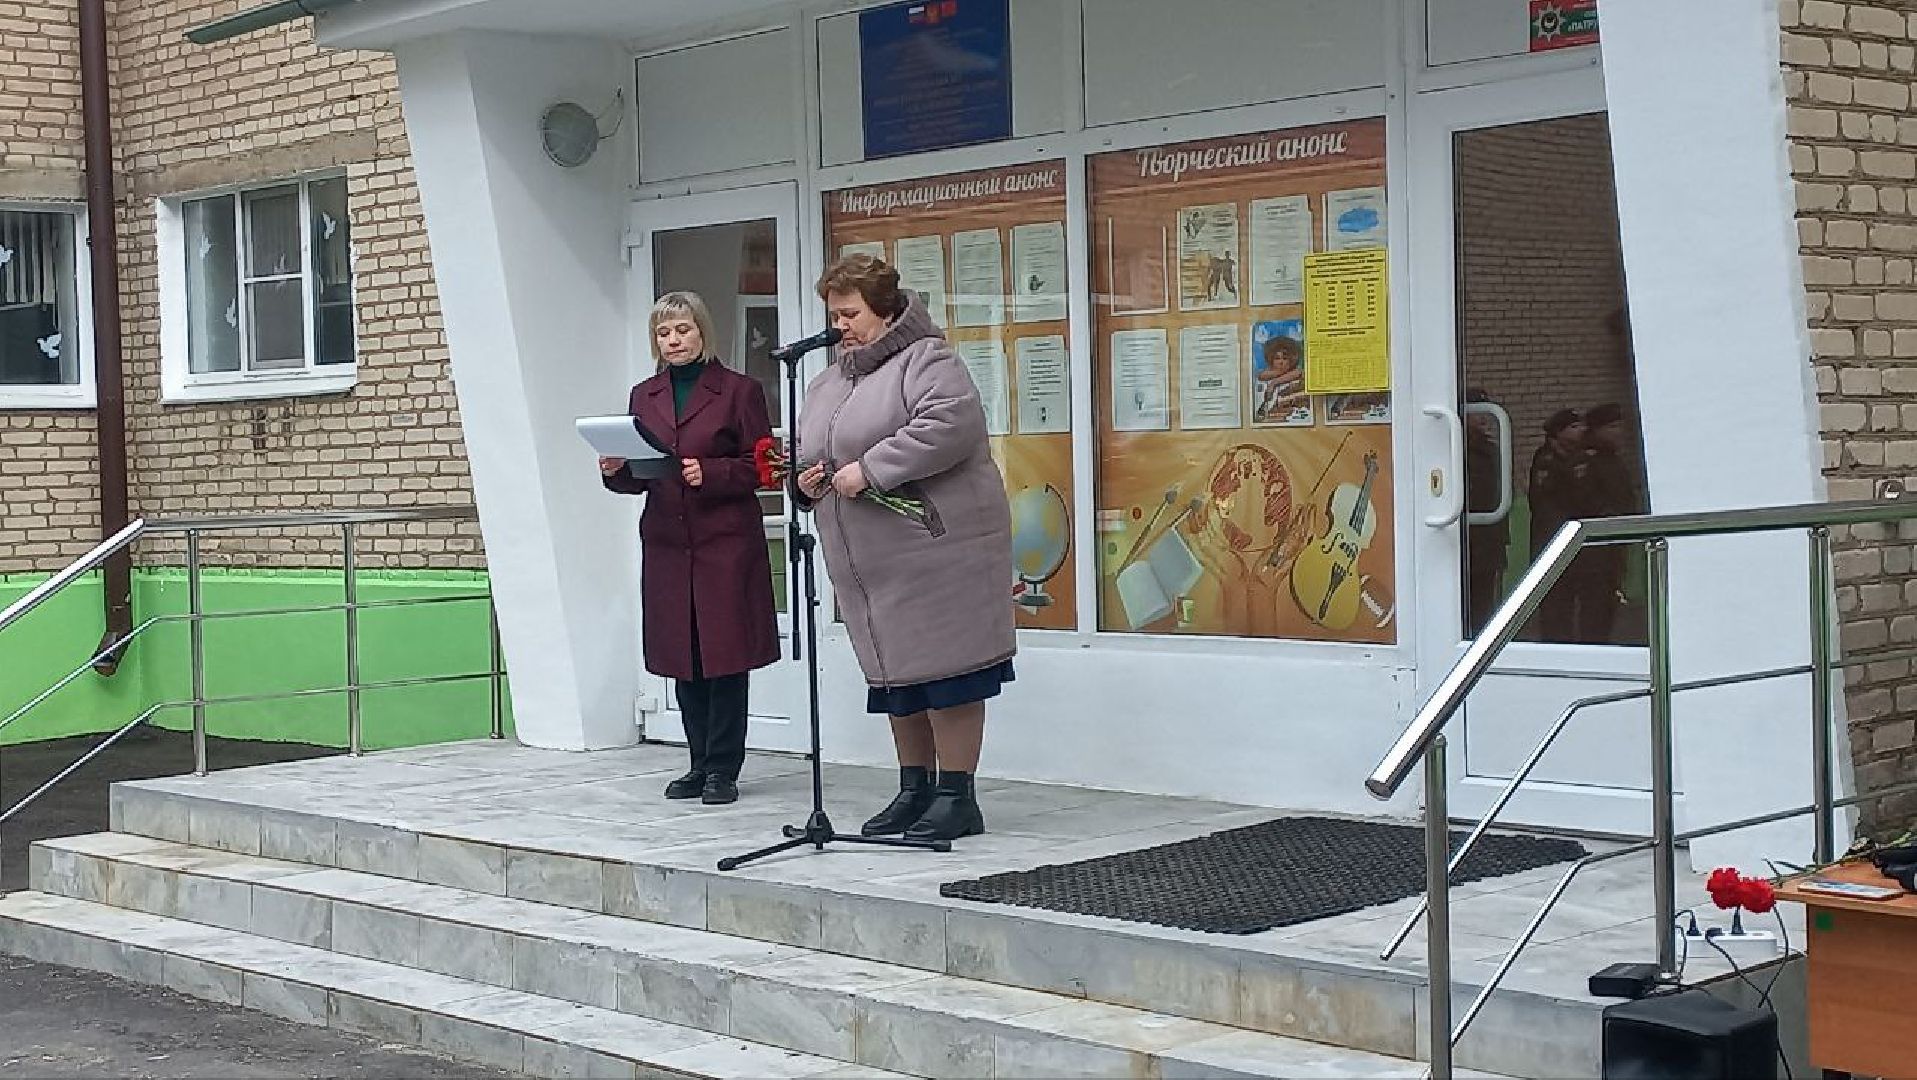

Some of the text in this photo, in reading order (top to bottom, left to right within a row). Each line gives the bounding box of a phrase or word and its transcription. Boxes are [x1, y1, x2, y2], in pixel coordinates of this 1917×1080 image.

[1136, 131, 1348, 182] Творческий анонс
[840, 169, 1058, 216] Информационный анонс
